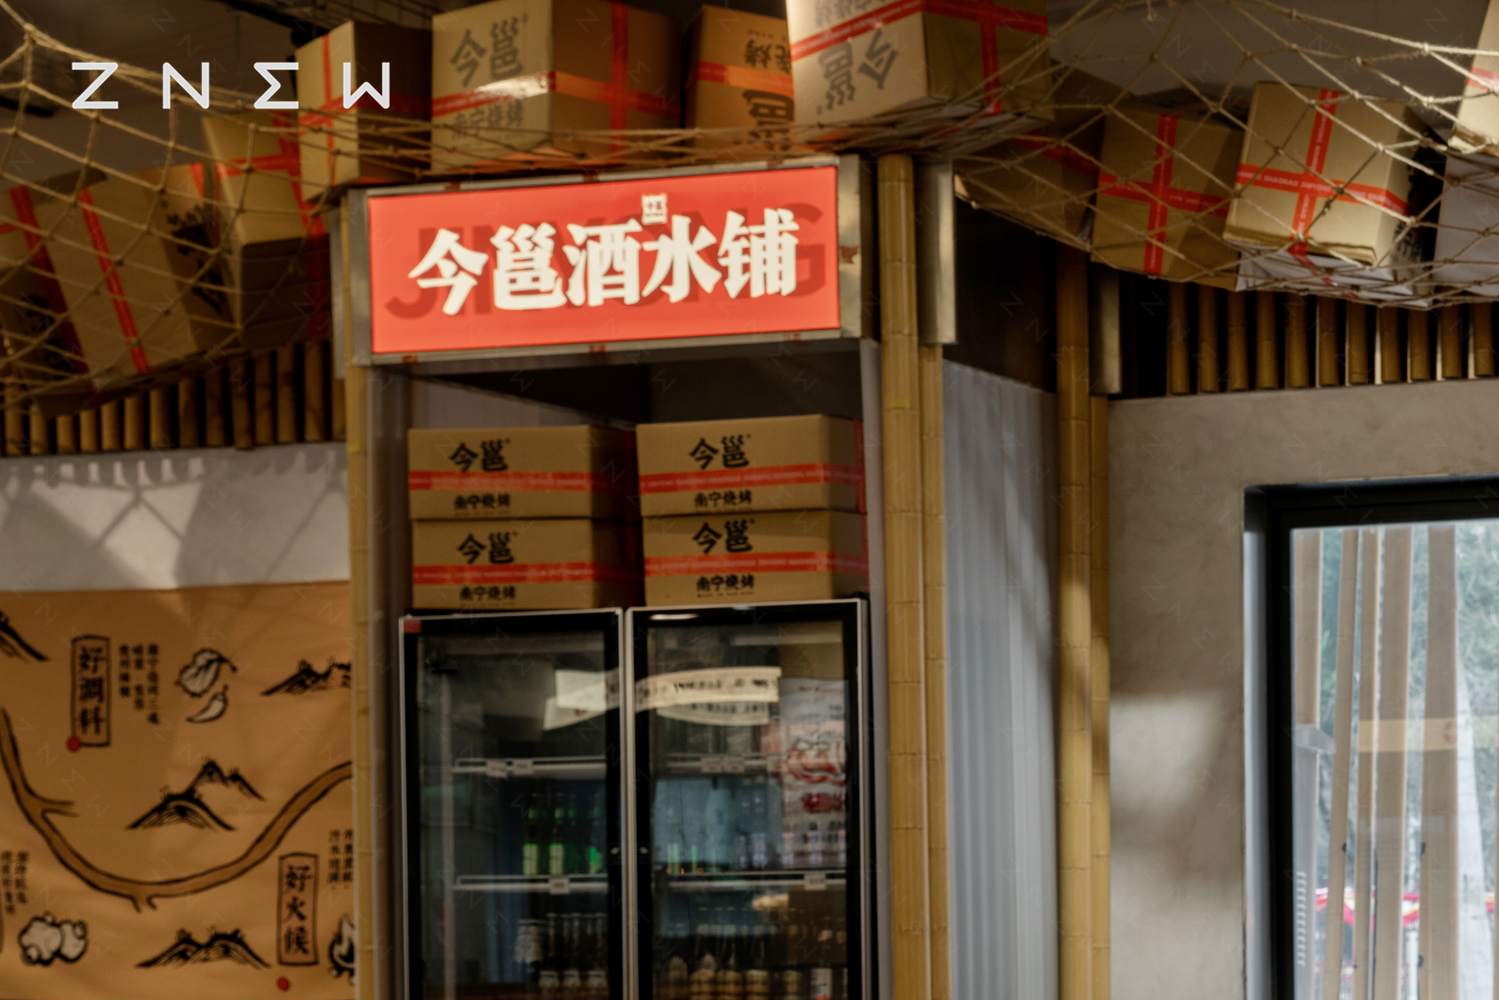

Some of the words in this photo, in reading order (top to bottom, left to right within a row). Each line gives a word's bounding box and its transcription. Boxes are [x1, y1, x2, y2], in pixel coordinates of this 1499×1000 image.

[408, 208, 799, 315] 今邕酒水铺
[286, 865, 312, 954] 好火候
